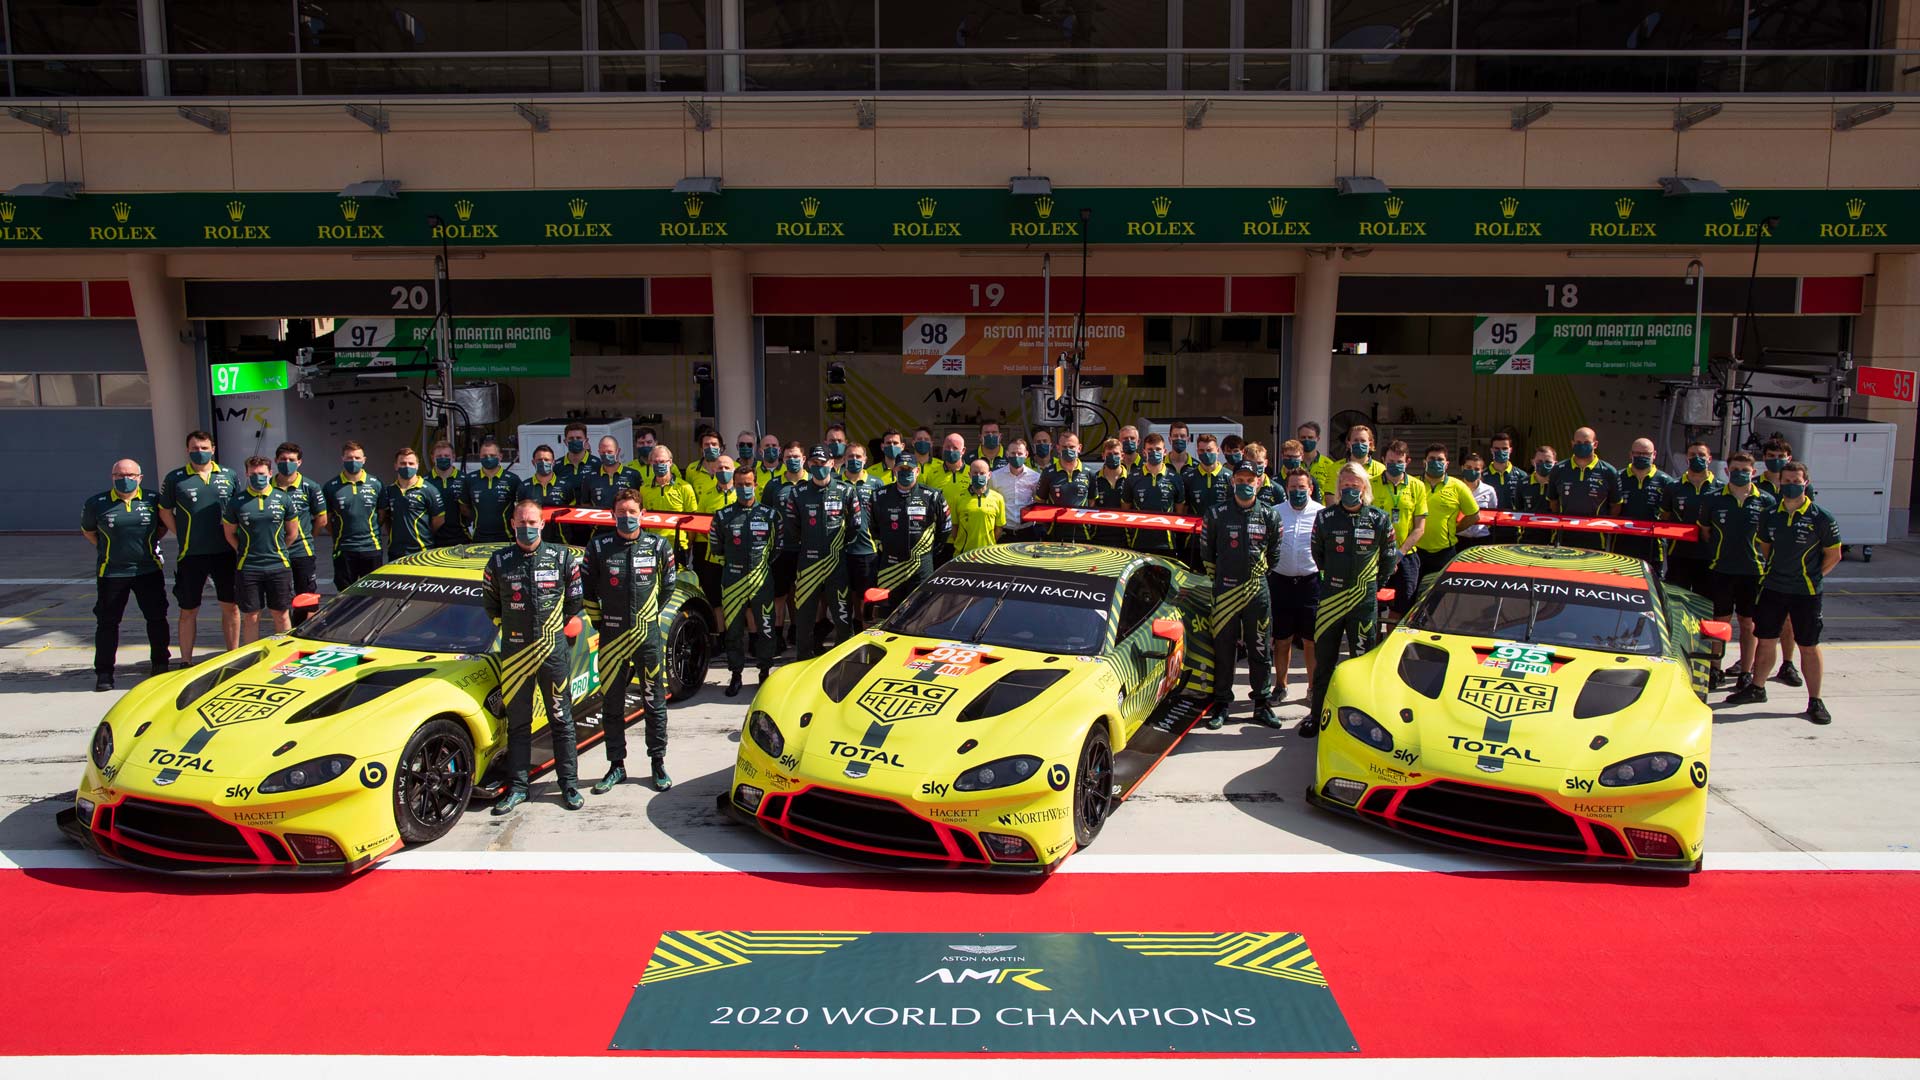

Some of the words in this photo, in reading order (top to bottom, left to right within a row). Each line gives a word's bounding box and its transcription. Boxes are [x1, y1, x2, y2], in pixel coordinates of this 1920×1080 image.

[89, 226, 157, 240] ROLEX
[204, 225, 271, 239] ROLEX
[318, 225, 384, 239] ROLEX
[432, 224, 499, 238] ROLEX
[545, 223, 613, 237] ROLEX
[660, 222, 728, 236] ROLEX
[776, 222, 845, 236] ROLEX
[893, 222, 961, 236] ROLEX
[1009, 222, 1078, 236] ROLEX
[1127, 221, 1195, 236] ROLEX
[1243, 221, 1311, 236] ROLEX
[1359, 222, 1427, 236] ROLEX
[1474, 222, 1542, 236] ROLEX
[1589, 222, 1656, 236] ROLEX
[1704, 223, 1772, 237] ROLEX
[1820, 223, 1888, 237] ROLEX
[391, 287, 428, 310] 20
[969, 284, 1005, 307] 19
[1544, 284, 1578, 308] 18
[352, 326, 378, 346] 97
[455, 327, 503, 340] MARTIN
[507, 327, 551, 340] RACING
[921, 323, 948, 345] 98
[984, 325, 1023, 338] ASTON
[1491, 323, 1517, 344] 95
[1553, 324, 1592, 337] ASTON
[1596, 324, 1643, 337] MARTIN
[1647, 324, 1693, 337] RACING
[218, 367, 239, 391] 97
[1893, 374, 1911, 399] 95
[573, 508, 684, 524] TOAL
[1071, 508, 1196, 527] TOTAL
[1503, 511, 1651, 531] TOTAL
[356, 579, 395, 590] ASTON
[397, 581, 450, 594] MARTIN
[928, 576, 979, 588] ASTON
[977, 580, 1038, 593] MARTIN
[1041, 586, 1106, 602] RACING
[1441, 577, 1498, 589] ASTON
[1501, 580, 1569, 596] MARTIN
[1575, 588, 1646, 605] RACING
[299, 650, 353, 666] 97
[927, 648, 978, 664] 98
[1496, 646, 1548, 663] 95
[296, 666, 325, 677] PRO
[938, 665, 963, 676] AM
[1514, 663, 1547, 674] PRO
[572, 677, 588, 694] PRO
[882, 681, 946, 699] TAG
[1472, 678, 1547, 698] TAG
[231, 687, 292, 704] TAG
[1465, 691, 1549, 715] HEUER
[203, 701, 272, 723] HEUER
[864, 694, 936, 718] HEUER
[829, 740, 905, 767] TOTAL
[1393, 748, 1419, 766] sky
[1448, 736, 1541, 763] TOTAL
[149, 749, 215, 772] TOTAL
[779, 754, 799, 771] sky
[225, 784, 254, 800] sky
[922, 781, 950, 797] sky
[1566, 776, 1594, 793] sky
[234, 811, 286, 821] HACKETT
[929, 808, 979, 818] HACKETT
[1574, 803, 1625, 814] HACKETT
[915, 968, 1053, 991] AMR
[709, 1006, 809, 1025] 2020
[822, 1006, 981, 1026] WORLD
[996, 1006, 1257, 1026] CHAMPIONS
